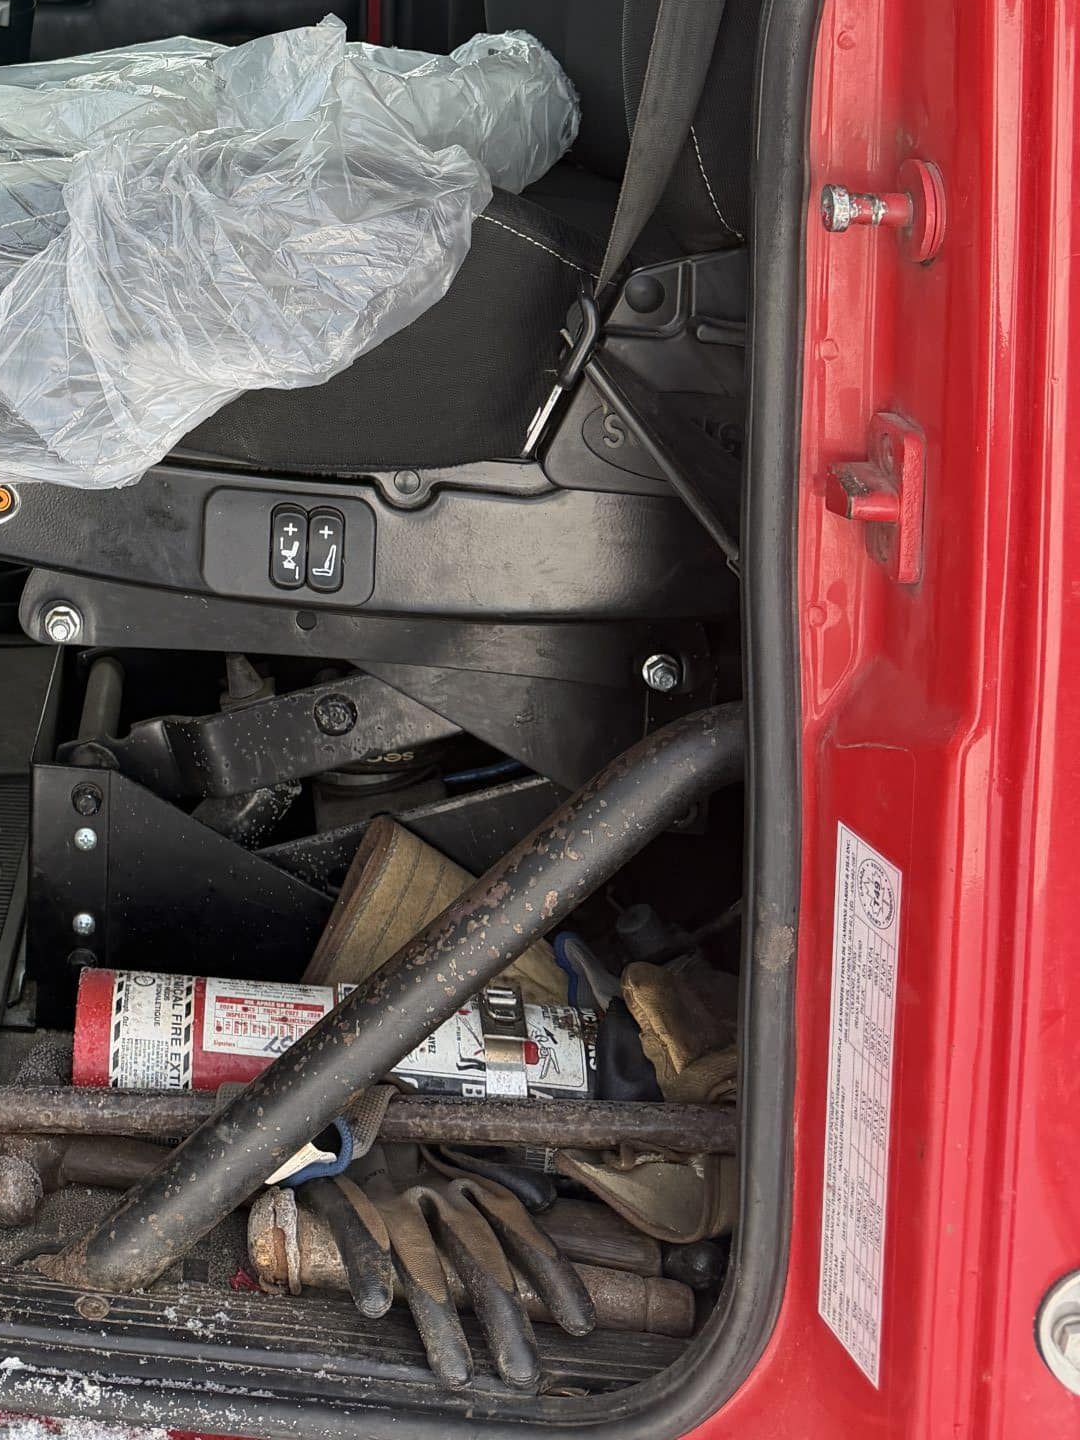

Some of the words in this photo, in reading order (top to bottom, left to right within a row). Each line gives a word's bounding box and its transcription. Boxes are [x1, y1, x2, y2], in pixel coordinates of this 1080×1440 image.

[873, 881, 881, 907] T49
[226, 1011, 257, 1020] INSPECTION
[170, 1013, 184, 1047] FIRE
[428, 1032, 436, 1054] AYEZ
[168, 1052, 182, 1088] EXTI
